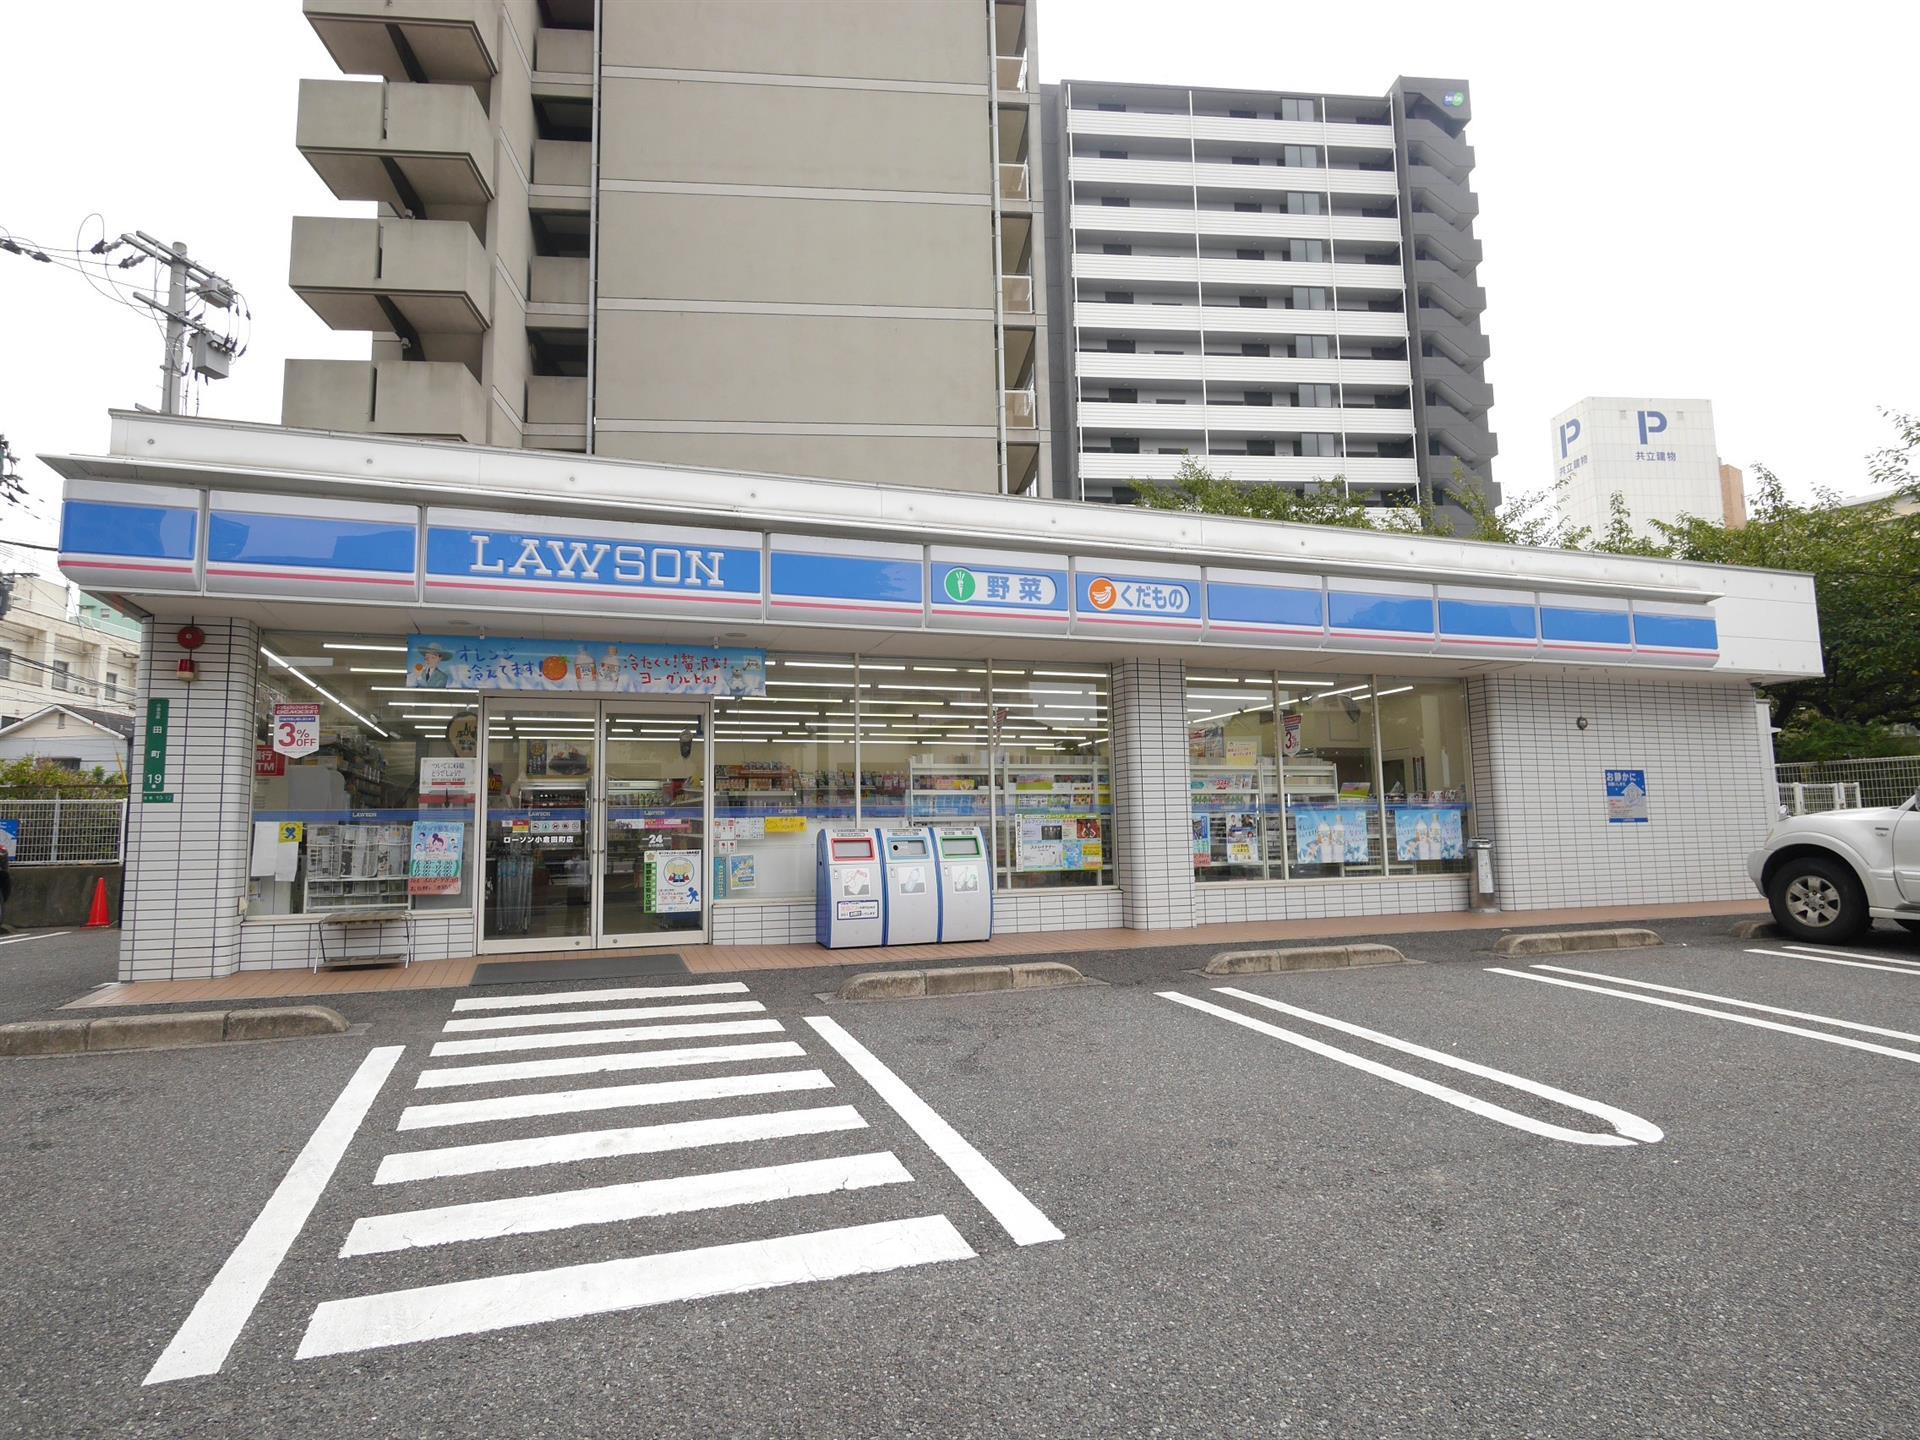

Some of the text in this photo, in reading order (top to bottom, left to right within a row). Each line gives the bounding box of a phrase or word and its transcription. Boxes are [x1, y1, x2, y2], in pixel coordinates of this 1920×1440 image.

[1636, 410, 1668, 445] P
[1560, 418, 1581, 460] P
[1559, 454, 1589, 475] 共立建物
[1635, 450, 1677, 462] 共立建物
[470, 535, 725, 587] LAWSON
[986, 575, 1042, 602] 野菜
[1121, 585, 1184, 610] くだもの
[455, 644, 515, 662] オレンジ
[151, 725, 163, 759] 田町
[279, 722, 309, 747] 3%
[296, 738, 316, 747] OFF
[147, 774, 162, 784] 19
[1606, 772, 1636, 782] お静かに
[503, 836, 574, 844] ローソン小倉田町店
[648, 834, 664, 845] 24
